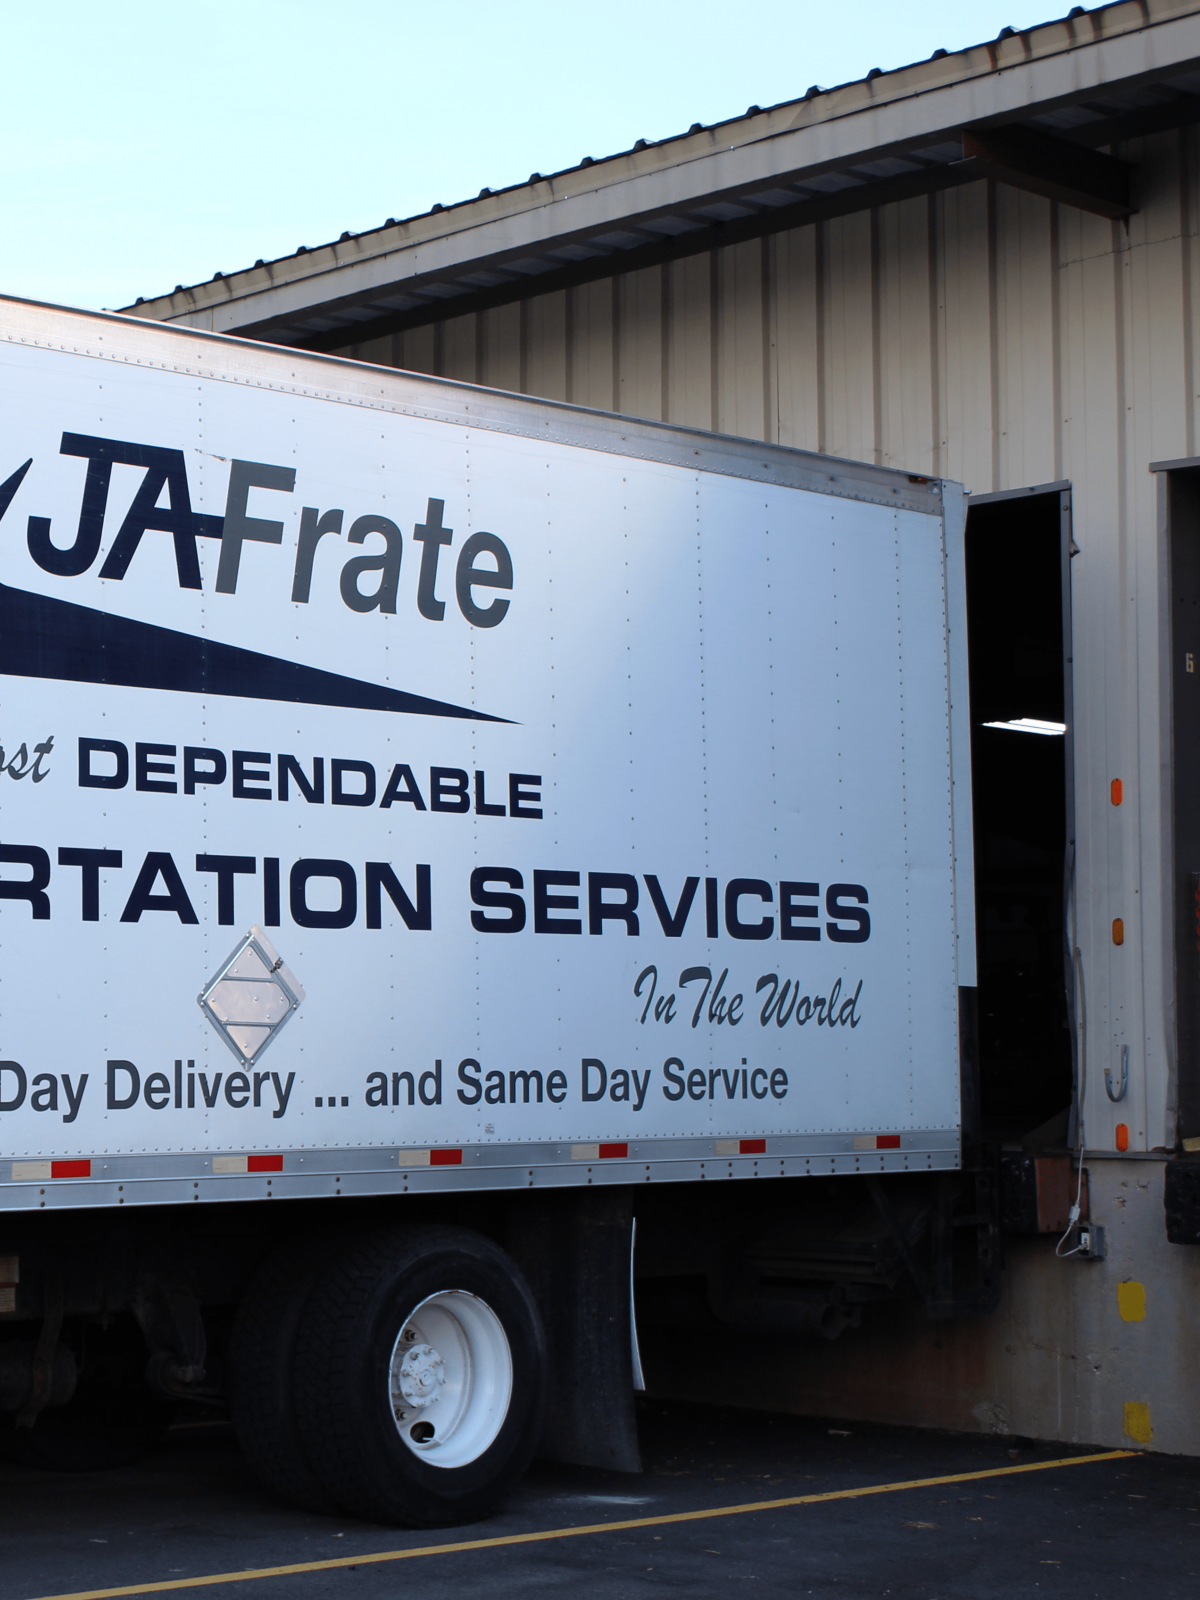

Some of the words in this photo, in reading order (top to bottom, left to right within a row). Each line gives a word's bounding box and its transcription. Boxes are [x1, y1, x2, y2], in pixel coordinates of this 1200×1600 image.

[79, 736, 544, 820] DEPENDABLE
[470, 866, 872, 944] SERVICES
[633, 964, 677, 1025] In
[678, 965, 744, 1029] The
[755, 972, 864, 1029] World
[105, 1059, 296, 1119] Delivery
[365, 1059, 443, 1108] and
[456, 1057, 568, 1106] Same
[581, 1057, 652, 1112] Day
[662, 1056, 786, 1102] Service
